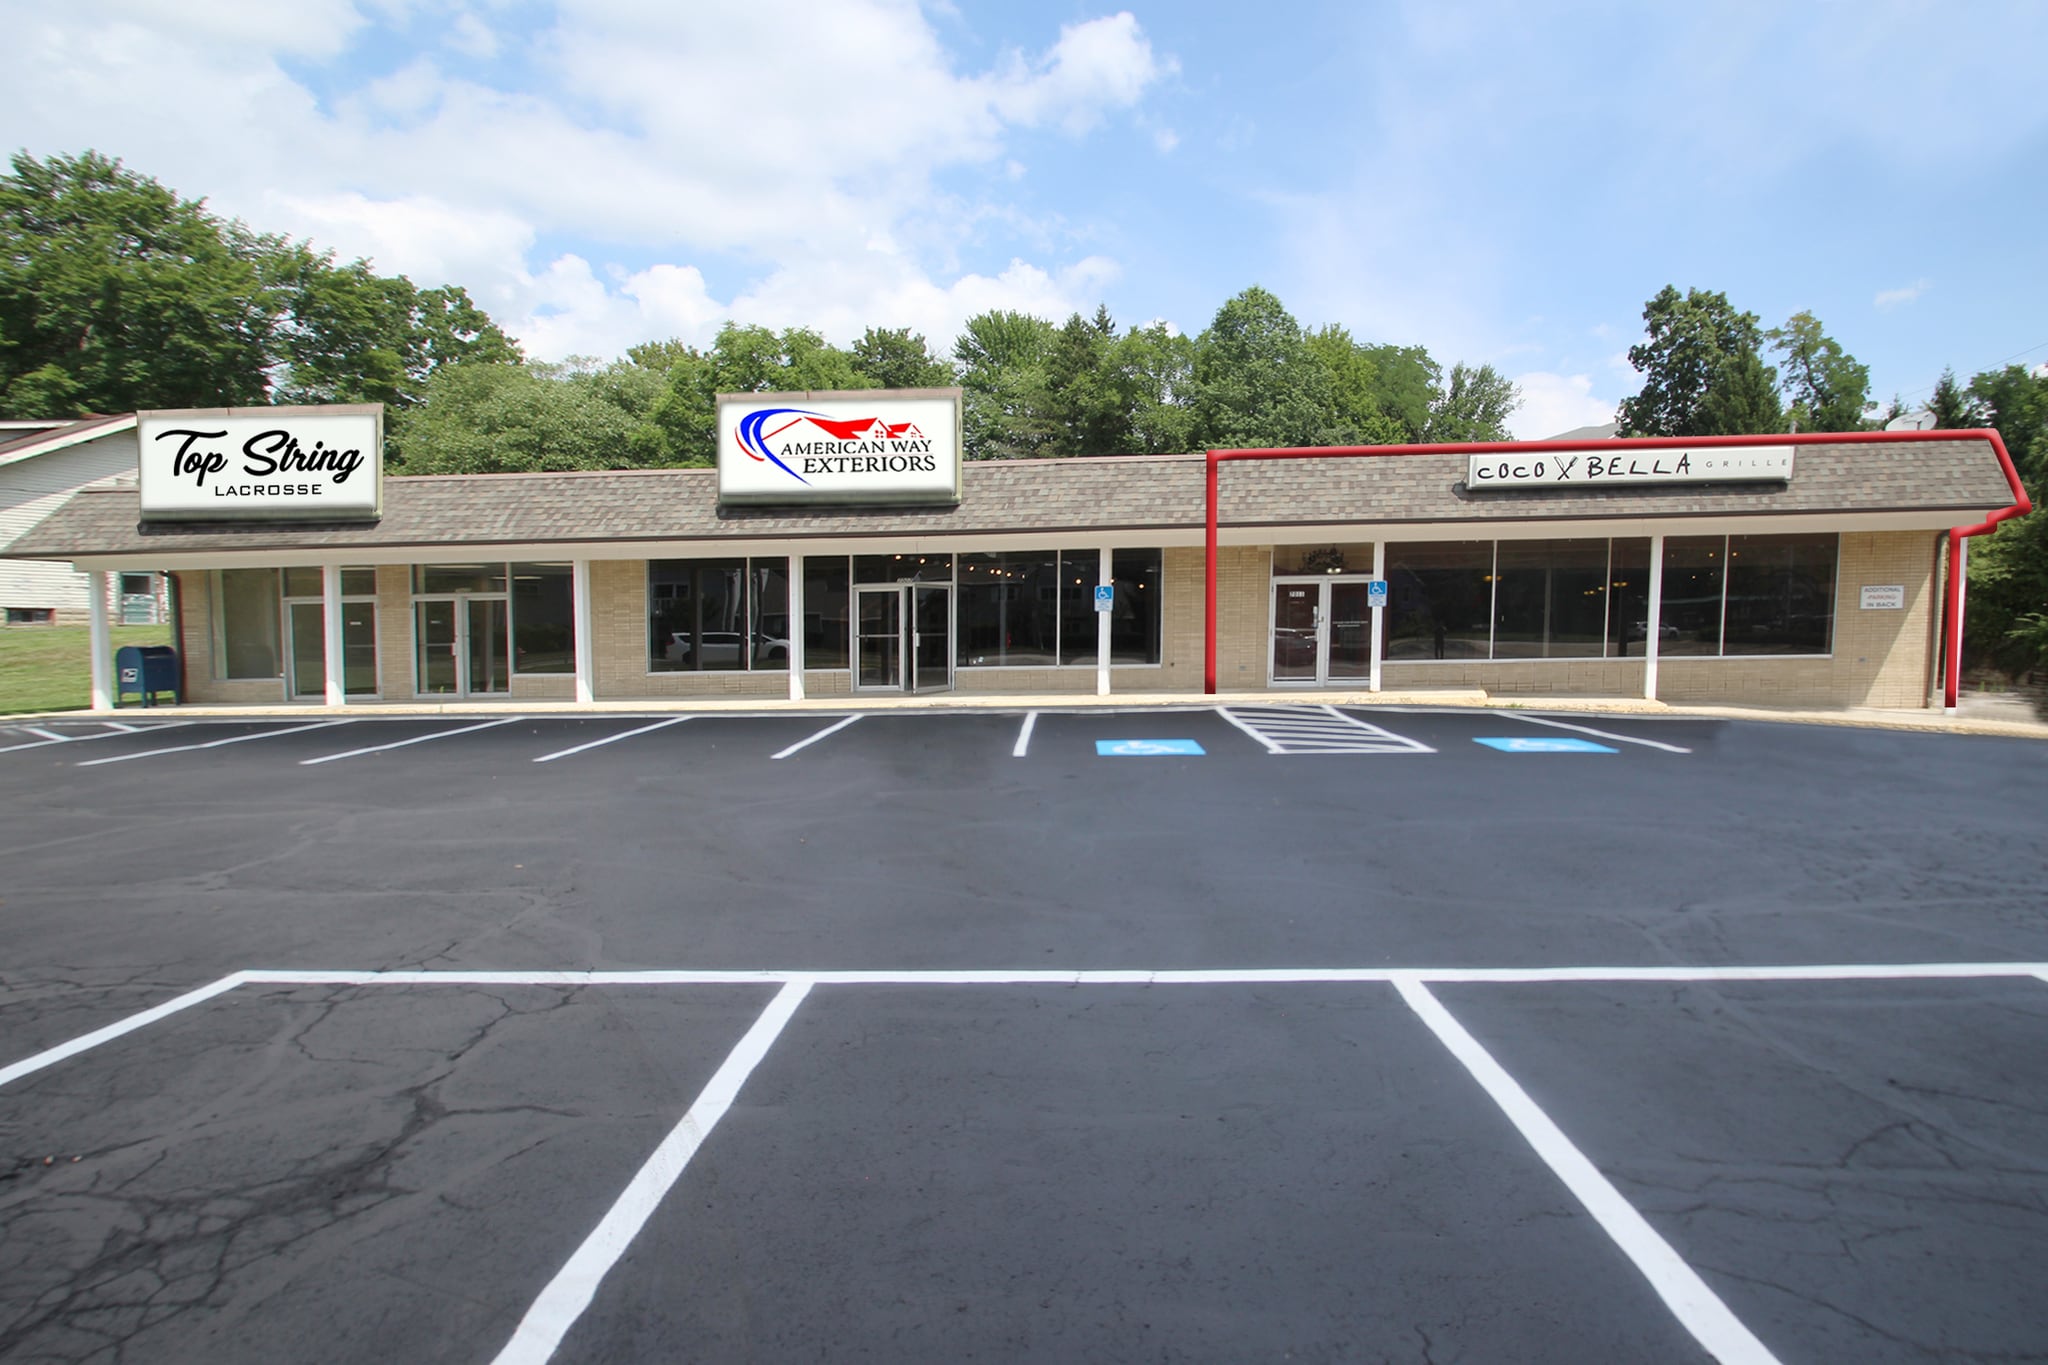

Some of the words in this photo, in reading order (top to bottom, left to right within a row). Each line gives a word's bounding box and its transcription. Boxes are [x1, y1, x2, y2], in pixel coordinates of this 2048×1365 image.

[781, 439, 885, 456] AMERICAN
[890, 439, 932, 453] WAY
[155, 429, 228, 487] Top
[242, 429, 364, 484] String
[803, 455, 936, 474] EXTERIORS
[1587, 453, 1691, 479] BELLA
[1705, 459, 1787, 469] GRILLE
[214, 484, 322, 497] LACROSSE
